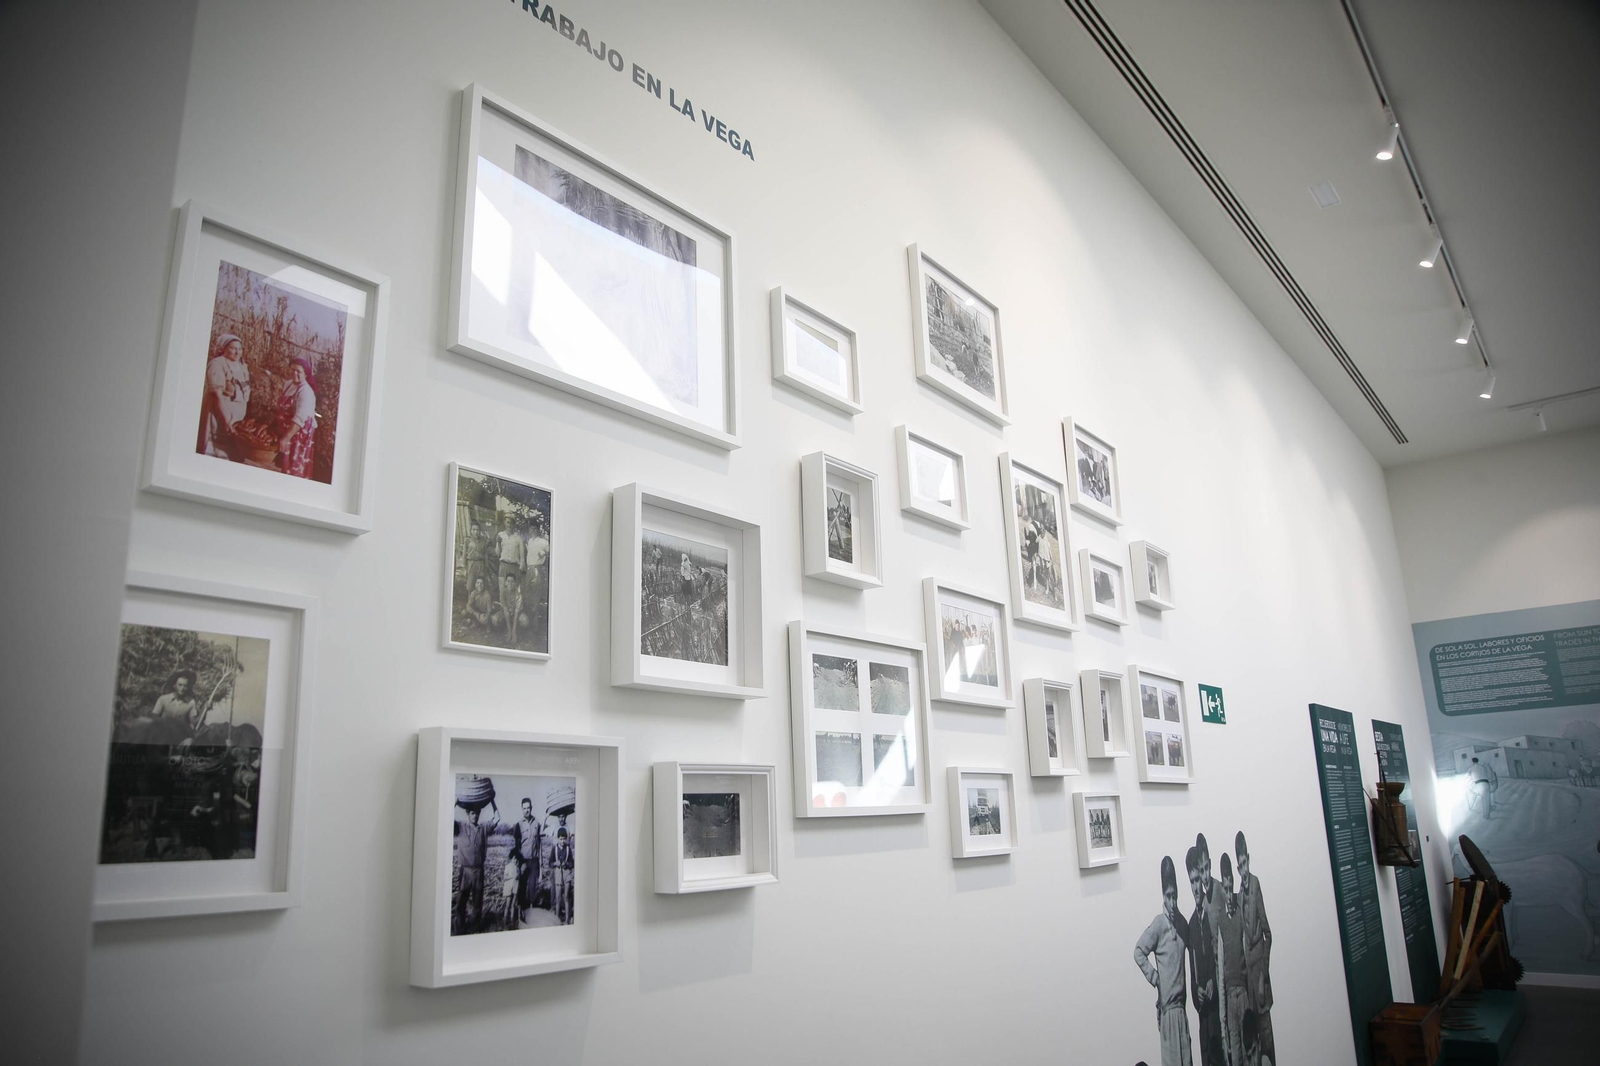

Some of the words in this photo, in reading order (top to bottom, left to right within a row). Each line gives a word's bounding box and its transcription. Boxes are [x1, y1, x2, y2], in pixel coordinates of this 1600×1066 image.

[511, 0, 624, 72] RABAJO
[632, 63, 661, 99] EN
[670, 88, 696, 122] LA
[701, 109, 755, 161] VEGA
[1479, 638, 1509, 648] LABORES
[1516, 635, 1545, 644] OFICIOS
[1553, 631, 1576, 639] FROM
[1555, 639, 1582, 647] TRADES
[1460, 650, 1491, 658] CORTIJOS
[1512, 644, 1533, 652] VEGA
